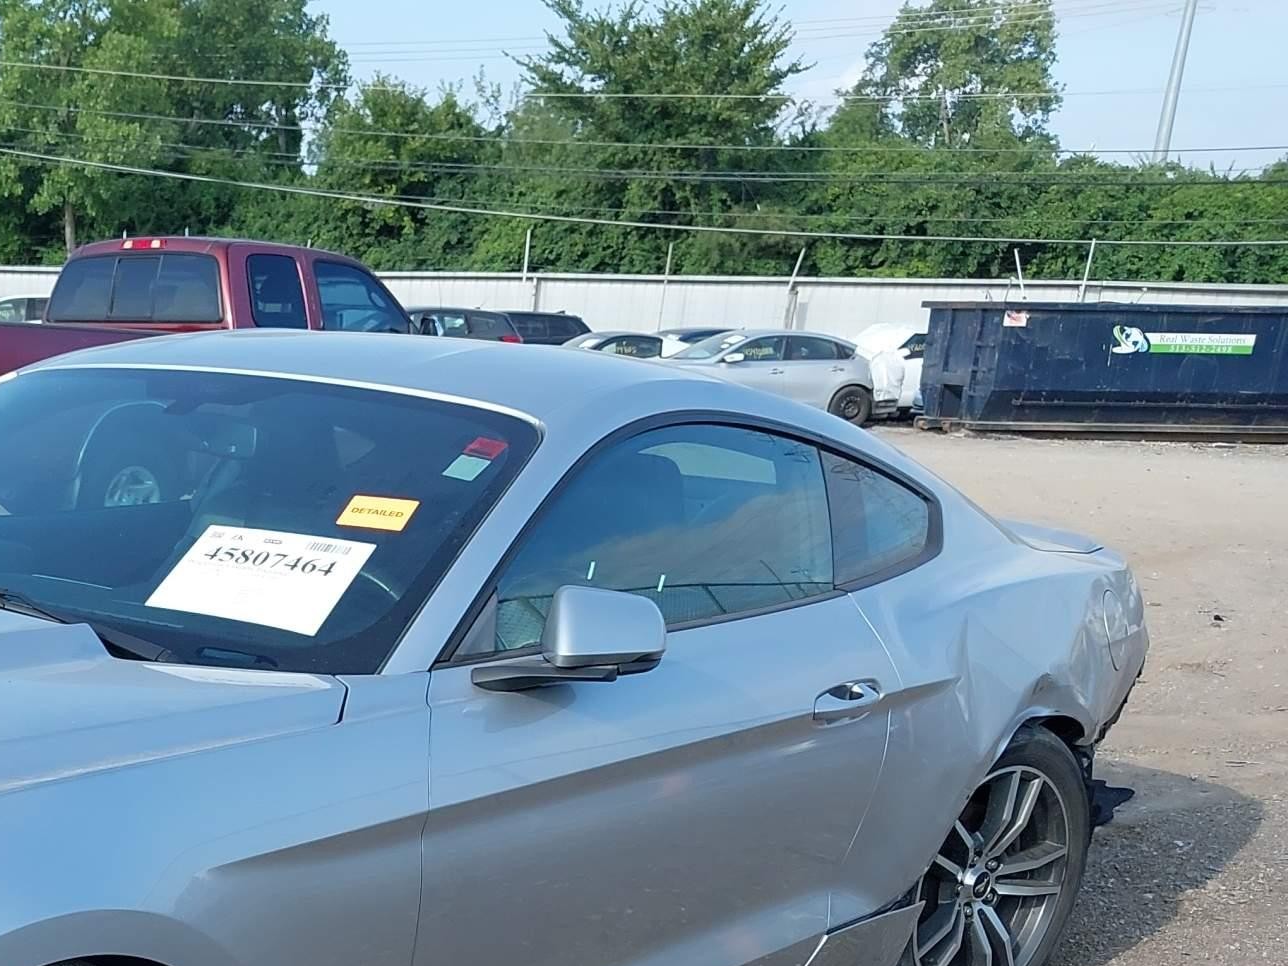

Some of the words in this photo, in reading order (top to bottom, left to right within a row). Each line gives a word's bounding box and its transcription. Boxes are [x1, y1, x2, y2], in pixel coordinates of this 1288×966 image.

[1159, 334, 1177, 343] Real
[1181, 335, 1206, 344] Waste
[1207, 335, 1246, 345] Solutions
[350, 506, 404, 519] DETAILED
[204, 545, 337, 577] 45807464
